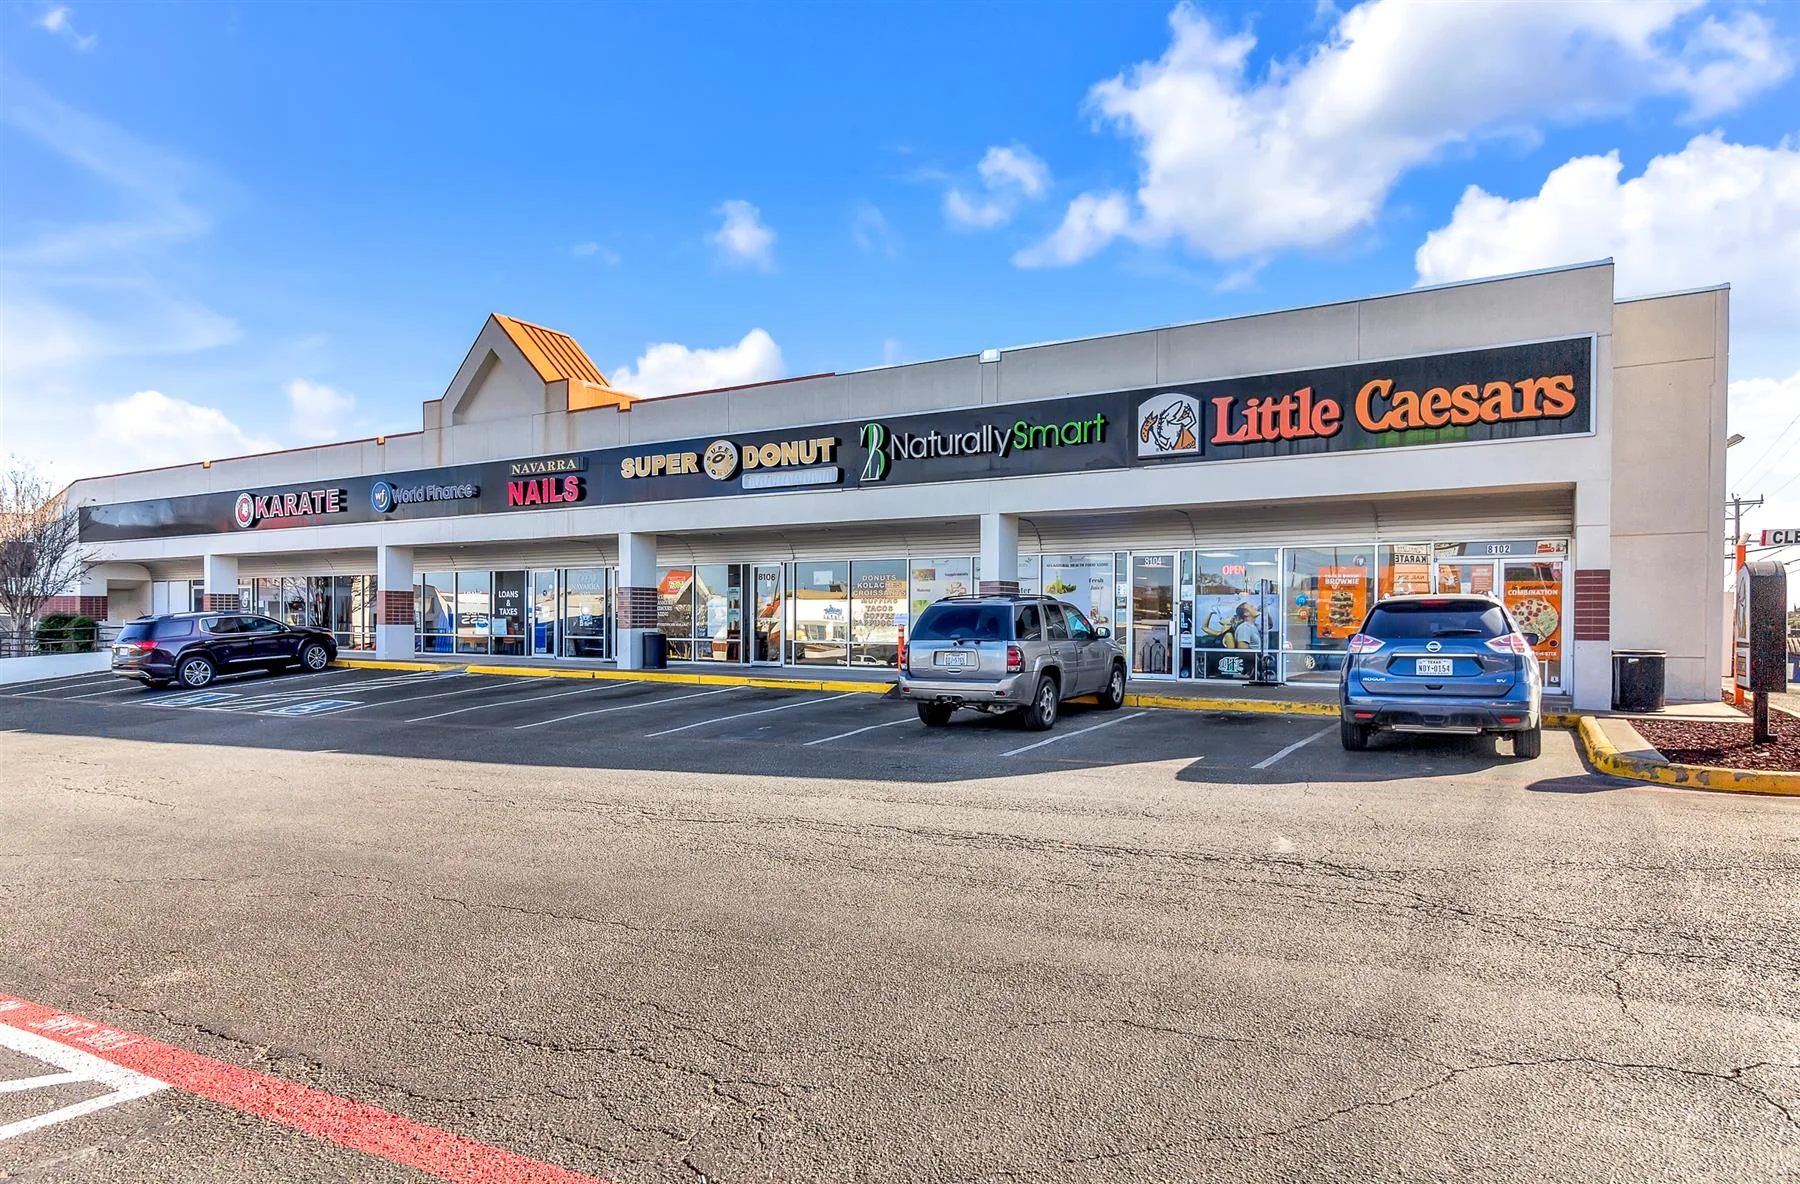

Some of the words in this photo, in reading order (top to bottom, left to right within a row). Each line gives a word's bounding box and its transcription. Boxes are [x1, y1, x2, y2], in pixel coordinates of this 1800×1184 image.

[1210, 386, 1342, 445] Little
[1354, 374, 1577, 431] Caesars
[620, 452, 699, 479] SUPER
[742, 437, 835, 469] DONUT
[511, 459, 577, 475] NAVARRA
[392, 486, 424, 504] World
[426, 484, 473, 500] Finance
[507, 475, 579, 506] NAILS
[255, 488, 340, 519] KARATE
[1487, 544, 1510, 554] 8102
[1144, 556, 1162, 566] 8104
[1222, 565, 1245, 575] OPEN
[758, 573, 776, 581] 8106
[498, 590, 519, 598] LOANS
[506, 599, 511, 607] &
[498, 607, 518, 616] TAXES
